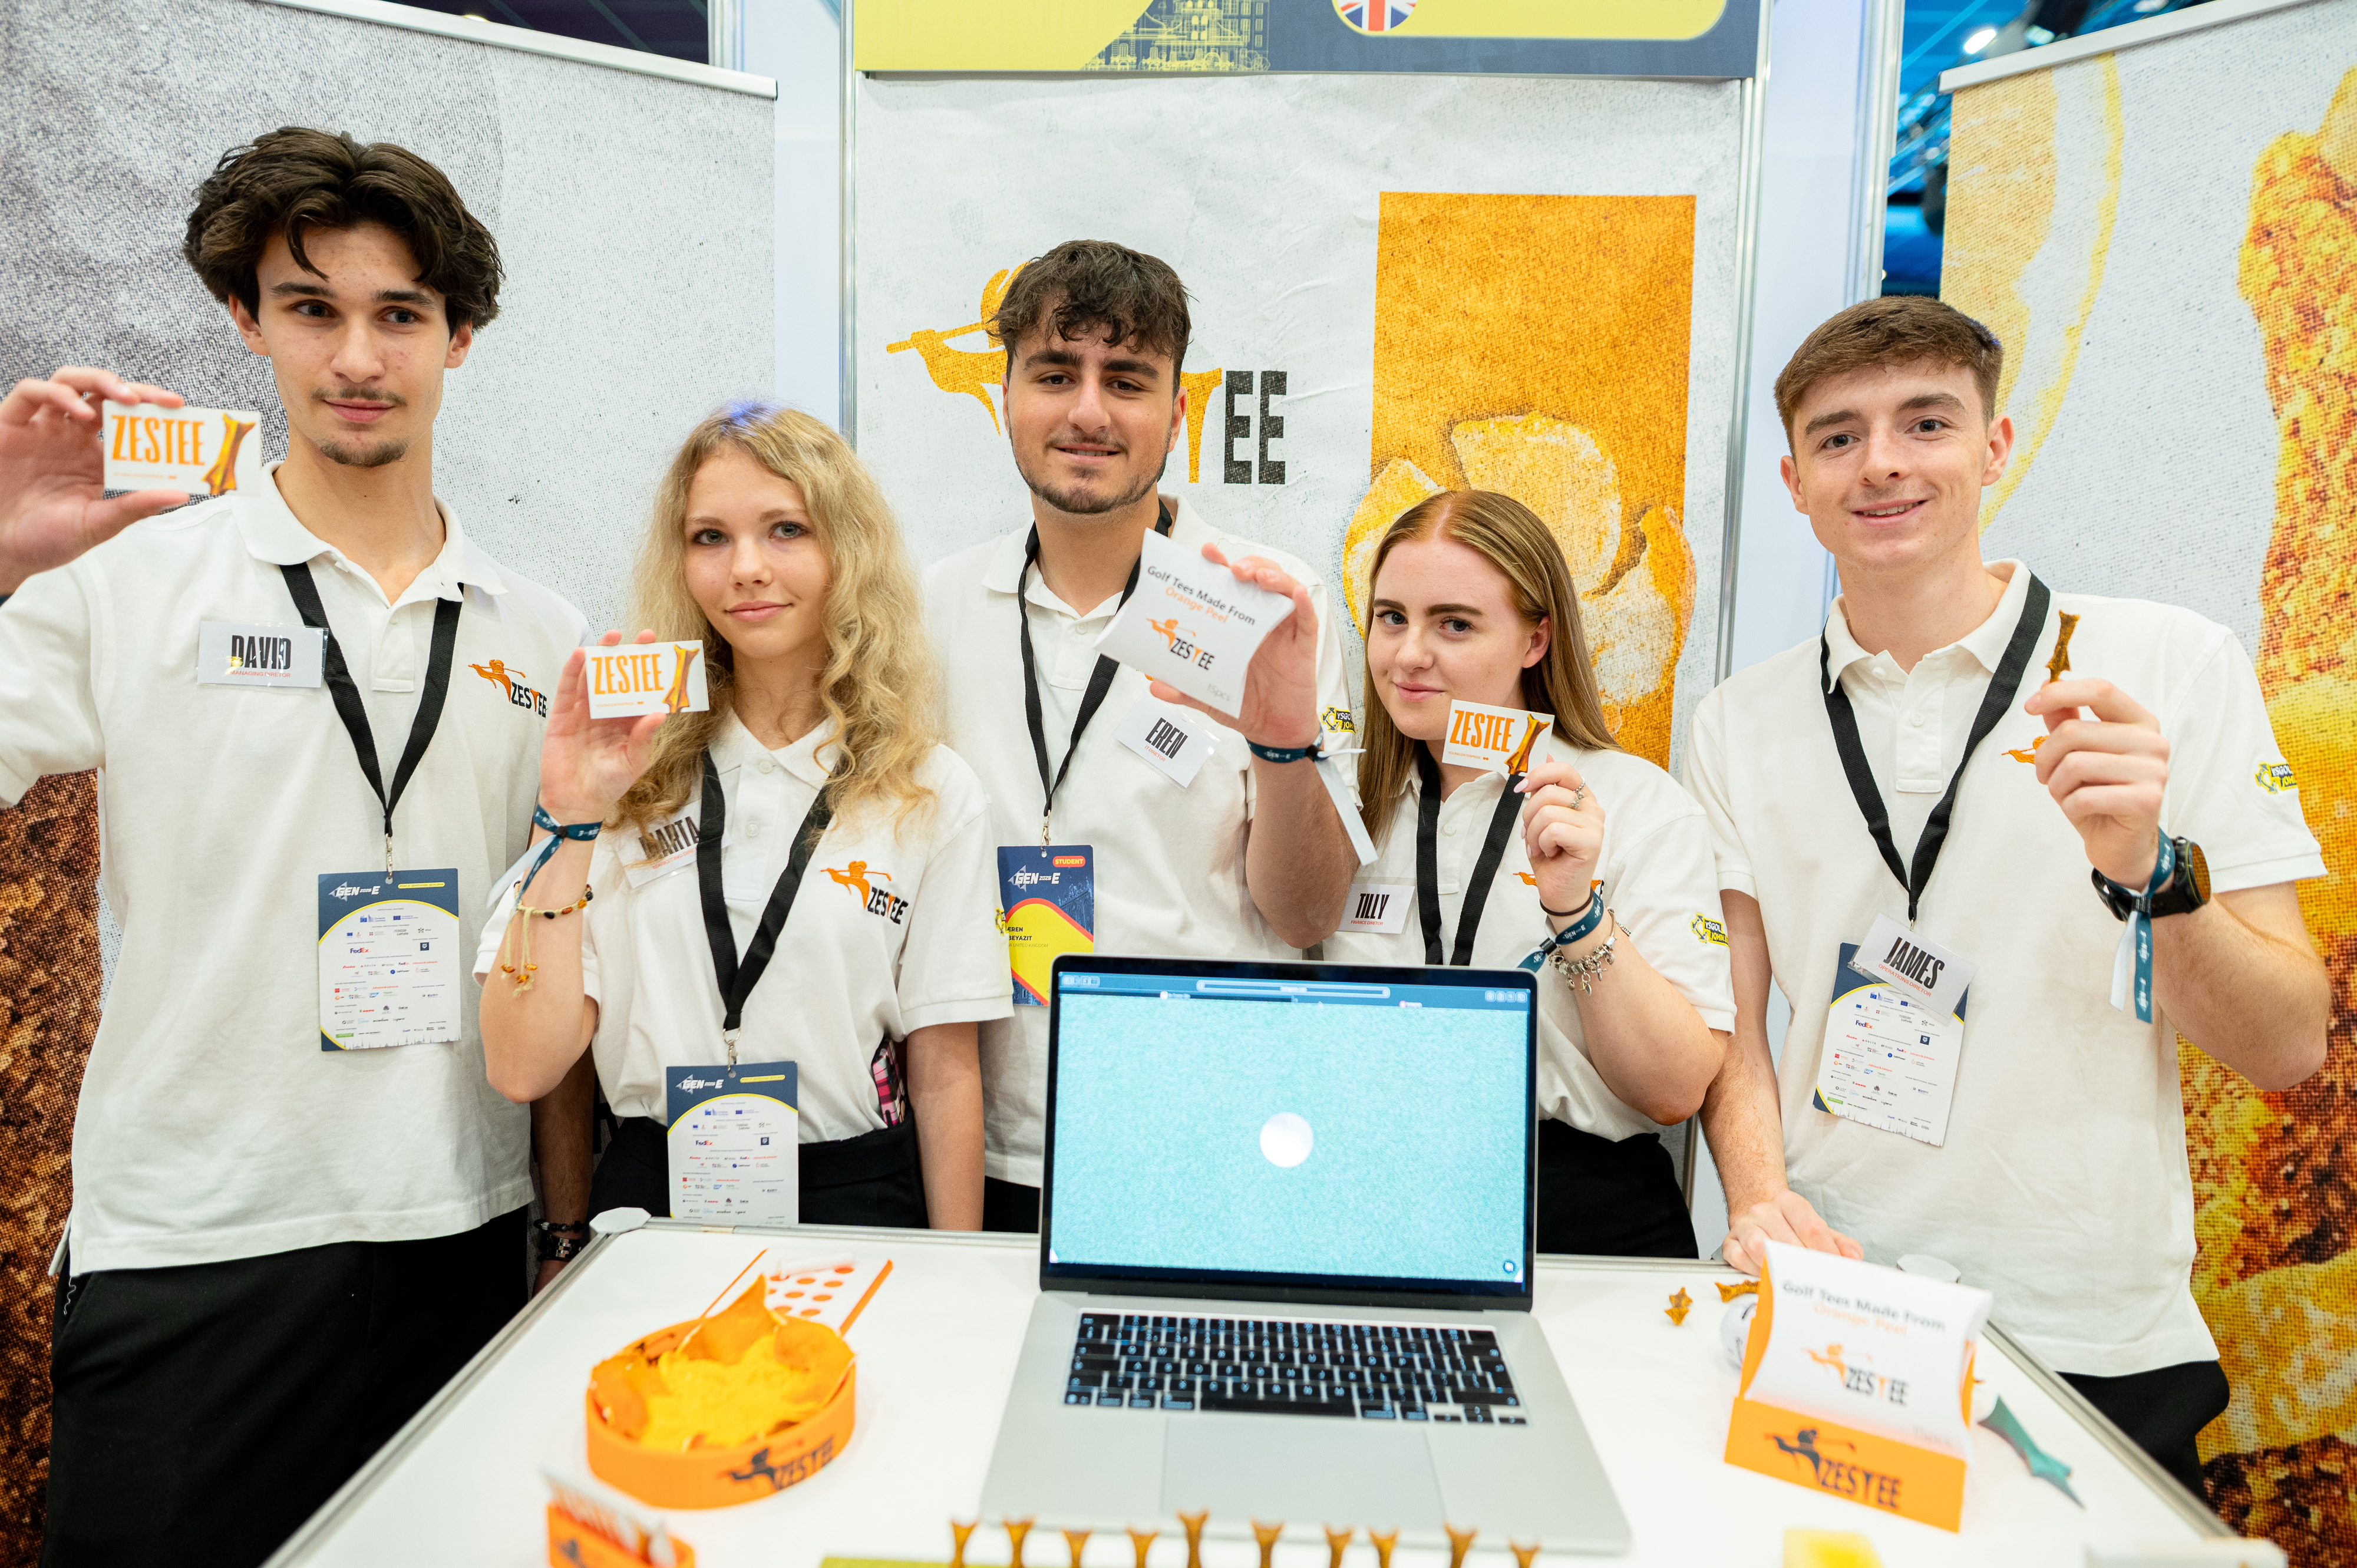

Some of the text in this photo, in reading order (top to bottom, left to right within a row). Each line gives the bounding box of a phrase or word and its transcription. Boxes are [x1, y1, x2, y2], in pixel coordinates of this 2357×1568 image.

[111, 414, 205, 466] ZESTEE
[1179, 367, 1287, 485] TEE
[1147, 565, 1256, 626] Golf Tees Made From
[1165, 586, 1229, 623] Orange Peel
[230, 635, 292, 670] DAVID
[1170, 636, 1216, 671] ZESTEE
[591, 653, 665, 695] ZESTEE
[1207, 682, 1232, 702] 15pcs
[511, 681, 547, 718] ZESTEE
[1337, 712, 1351, 721] YSGO
[1145, 717, 1189, 760] EREN
[1449, 709, 1515, 753] ZESTEE
[1148, 748, 1166, 762] DIRETOR
[335, 886, 360, 897] GEN
[371, 885, 381, 895] E
[1014, 872, 1039, 884] GEN
[1051, 872, 1061, 884] E
[867, 886, 909, 925] ZESTEE
[1355, 893, 1390, 919] TILLY
[1564, 929, 1577, 939] GEN
[1705, 921, 1722, 932] YSGOL
[1878, 963, 1932, 998] OPERATIONS DIRETOR
[1883, 936, 1946, 989] JAMES
[1856, 1020, 1873, 1029] FedEx
[682, 1079, 705, 1090] GEN
[715, 1079, 724, 1089] E
[1782, 1280, 1946, 1332] Golf Tees Made From
[1845, 1364, 1909, 1406] ZESTEE
[1820, 1458, 1904, 1510] ZESTEE
